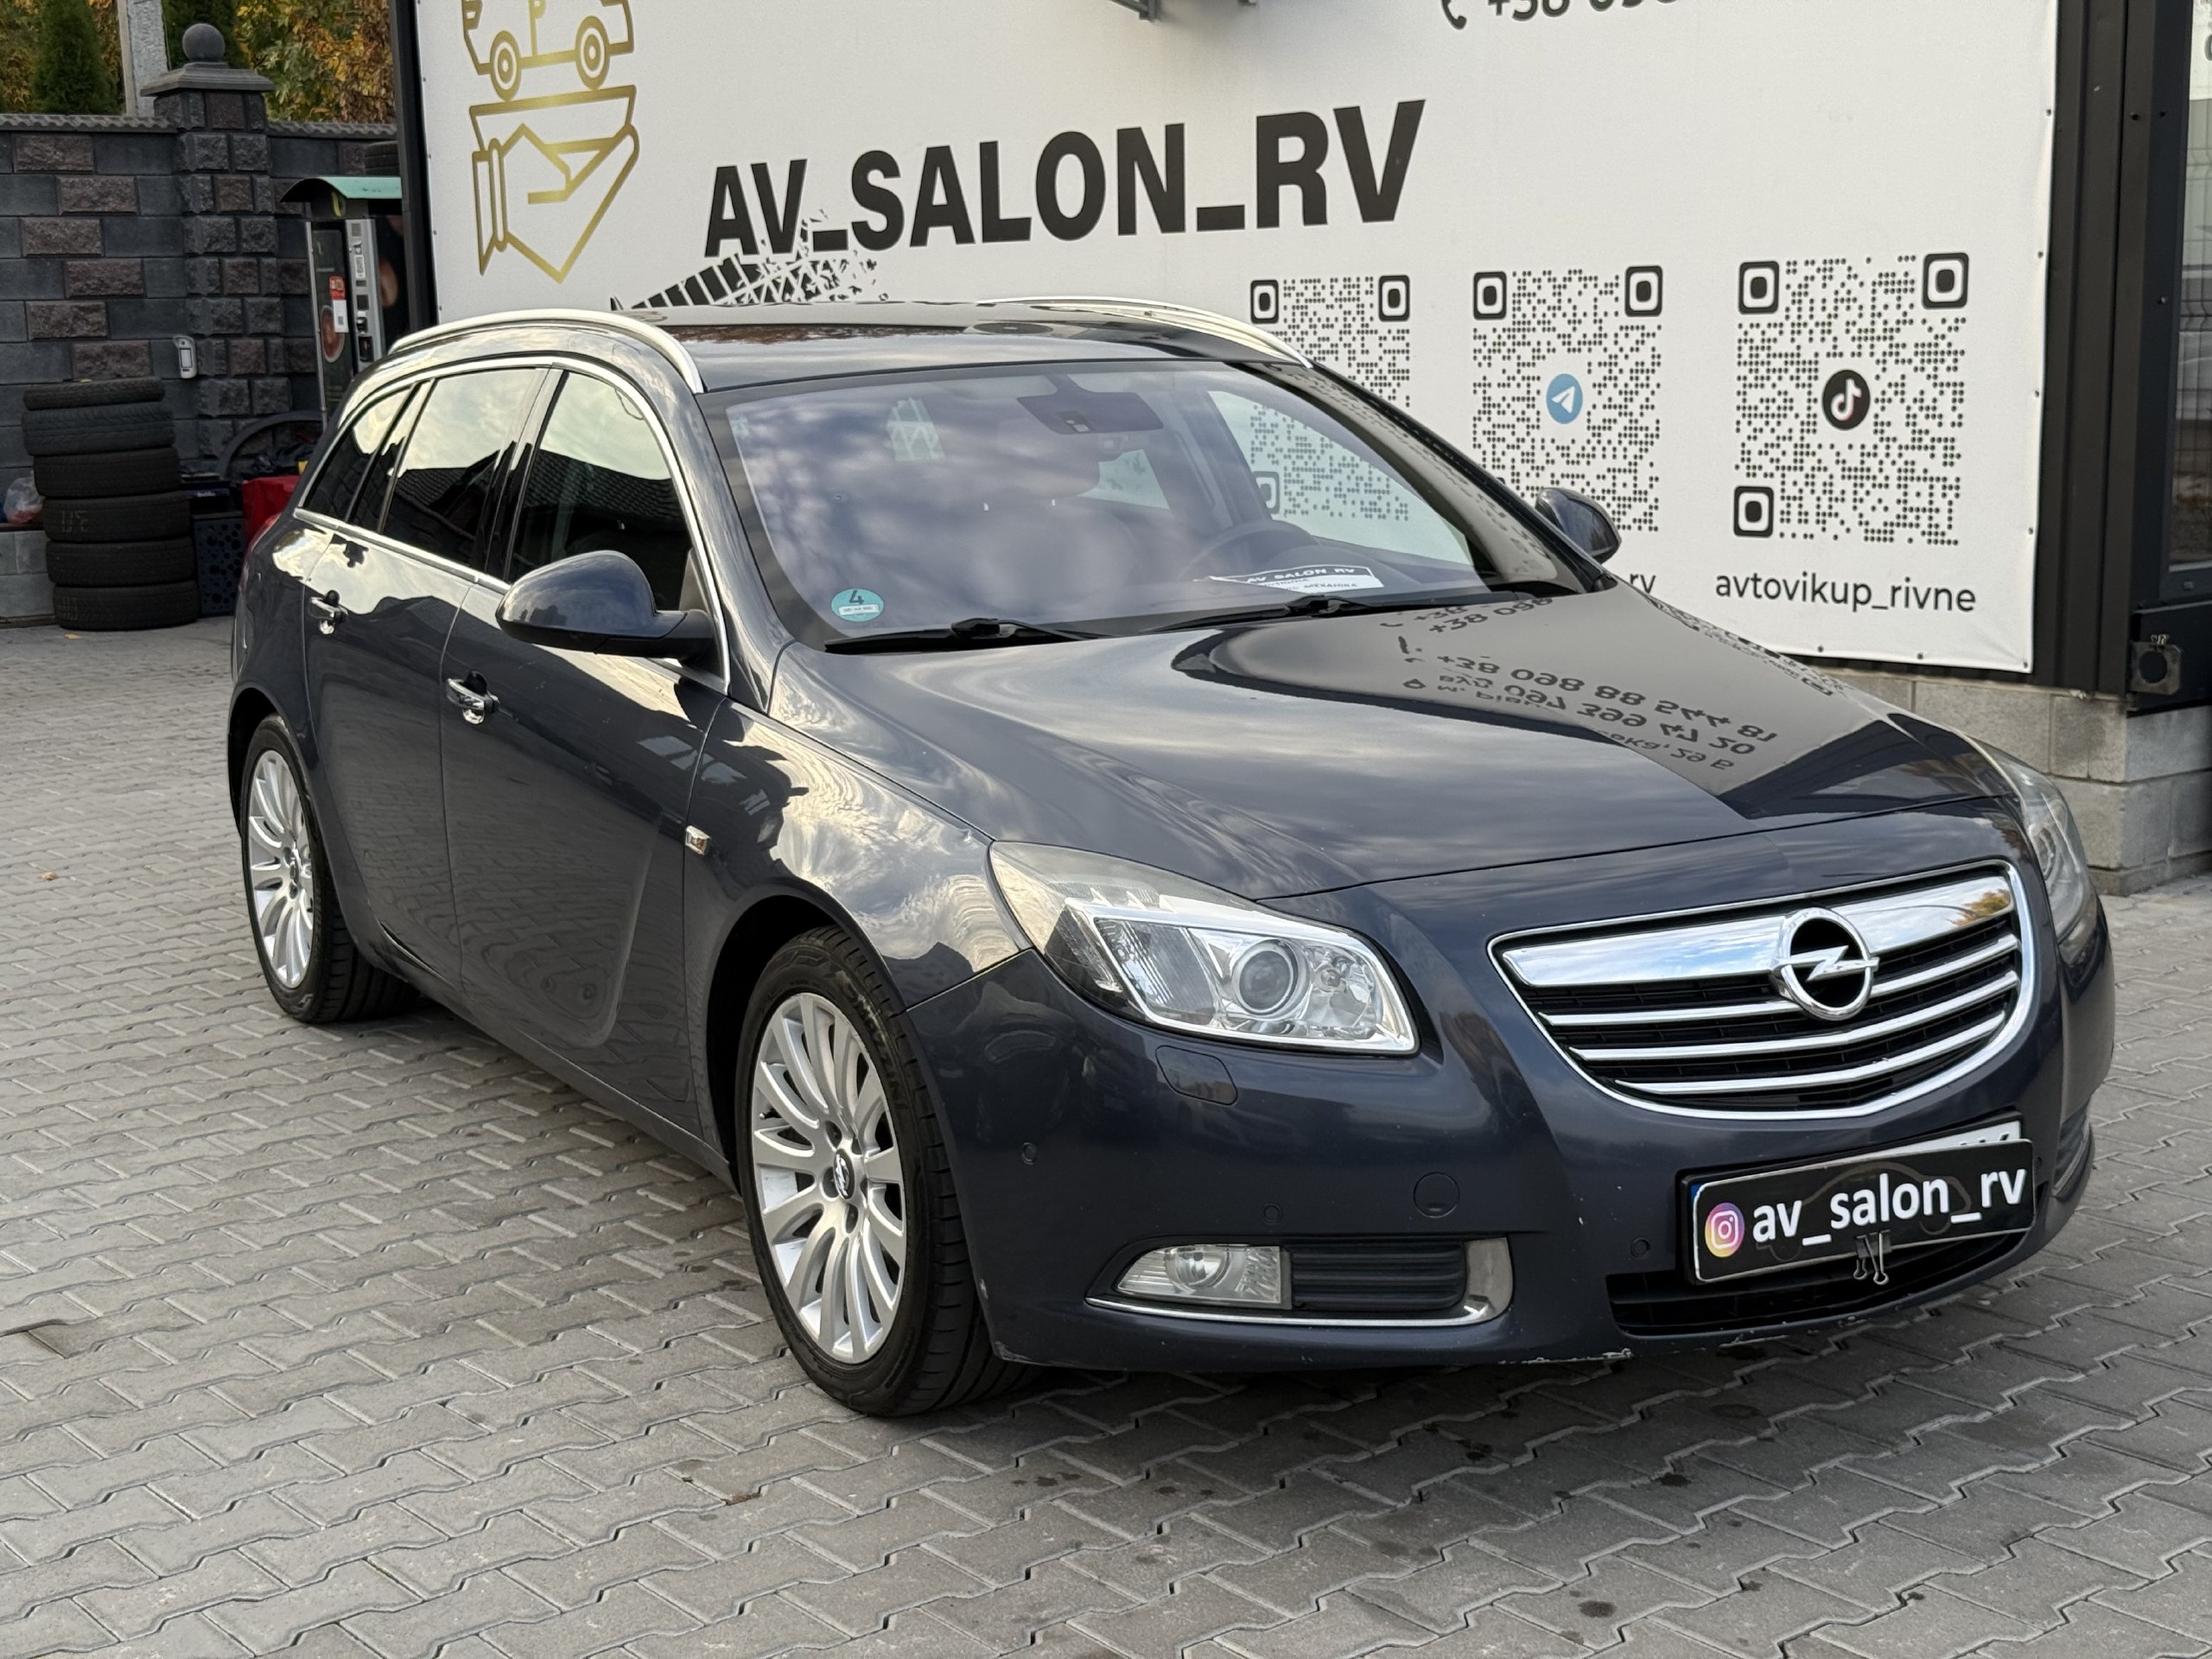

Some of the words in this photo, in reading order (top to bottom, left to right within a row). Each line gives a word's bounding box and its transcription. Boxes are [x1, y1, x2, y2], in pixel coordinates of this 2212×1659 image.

[703, 99, 1427, 257] AV_SALON_RV
[849, 589, 865, 605] 4
[1715, 571, 1977, 613] avtovikup_rivne
[1751, 1168, 2028, 1247] av_salon_rv
